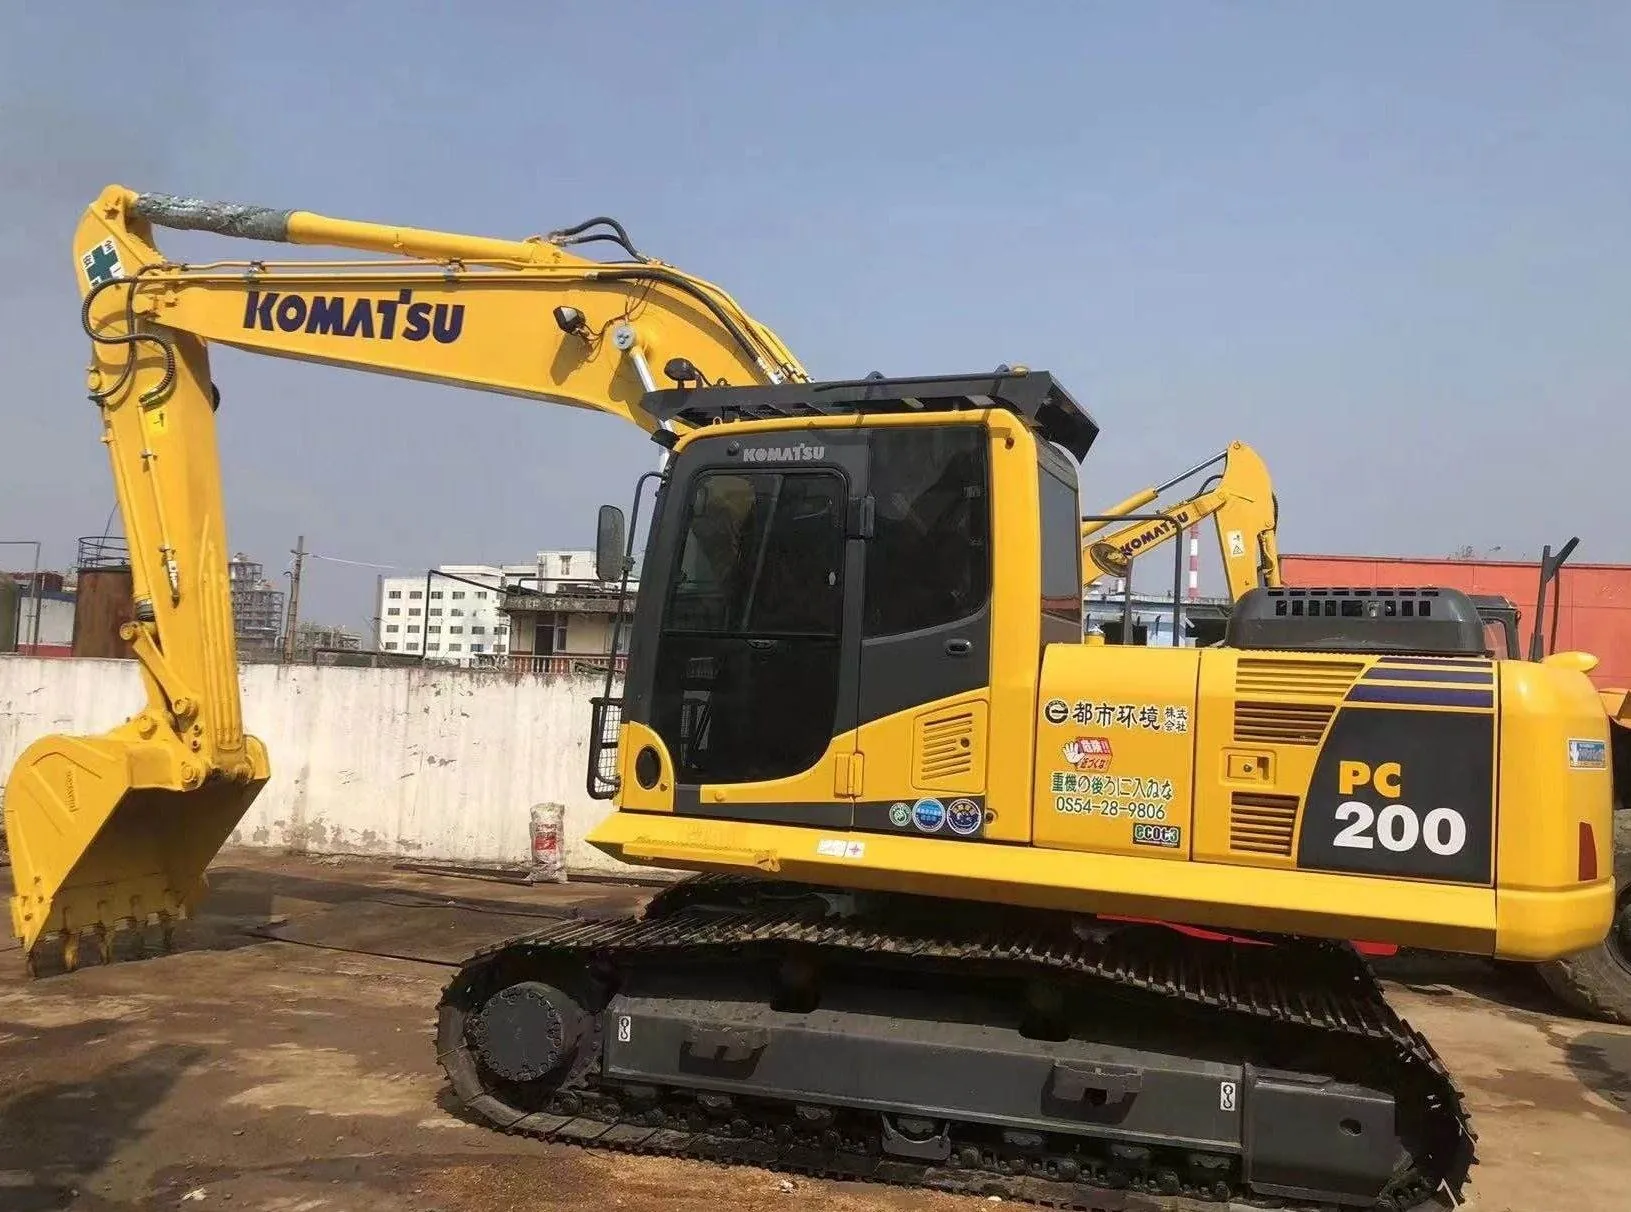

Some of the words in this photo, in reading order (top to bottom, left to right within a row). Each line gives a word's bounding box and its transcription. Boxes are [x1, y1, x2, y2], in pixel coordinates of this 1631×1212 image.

[243, 288, 465, 343] KOMATSU
[743, 442, 825, 462] KOMATSU
[1339, 761, 1401, 798] PC
[1333, 801, 1467, 856] 200
